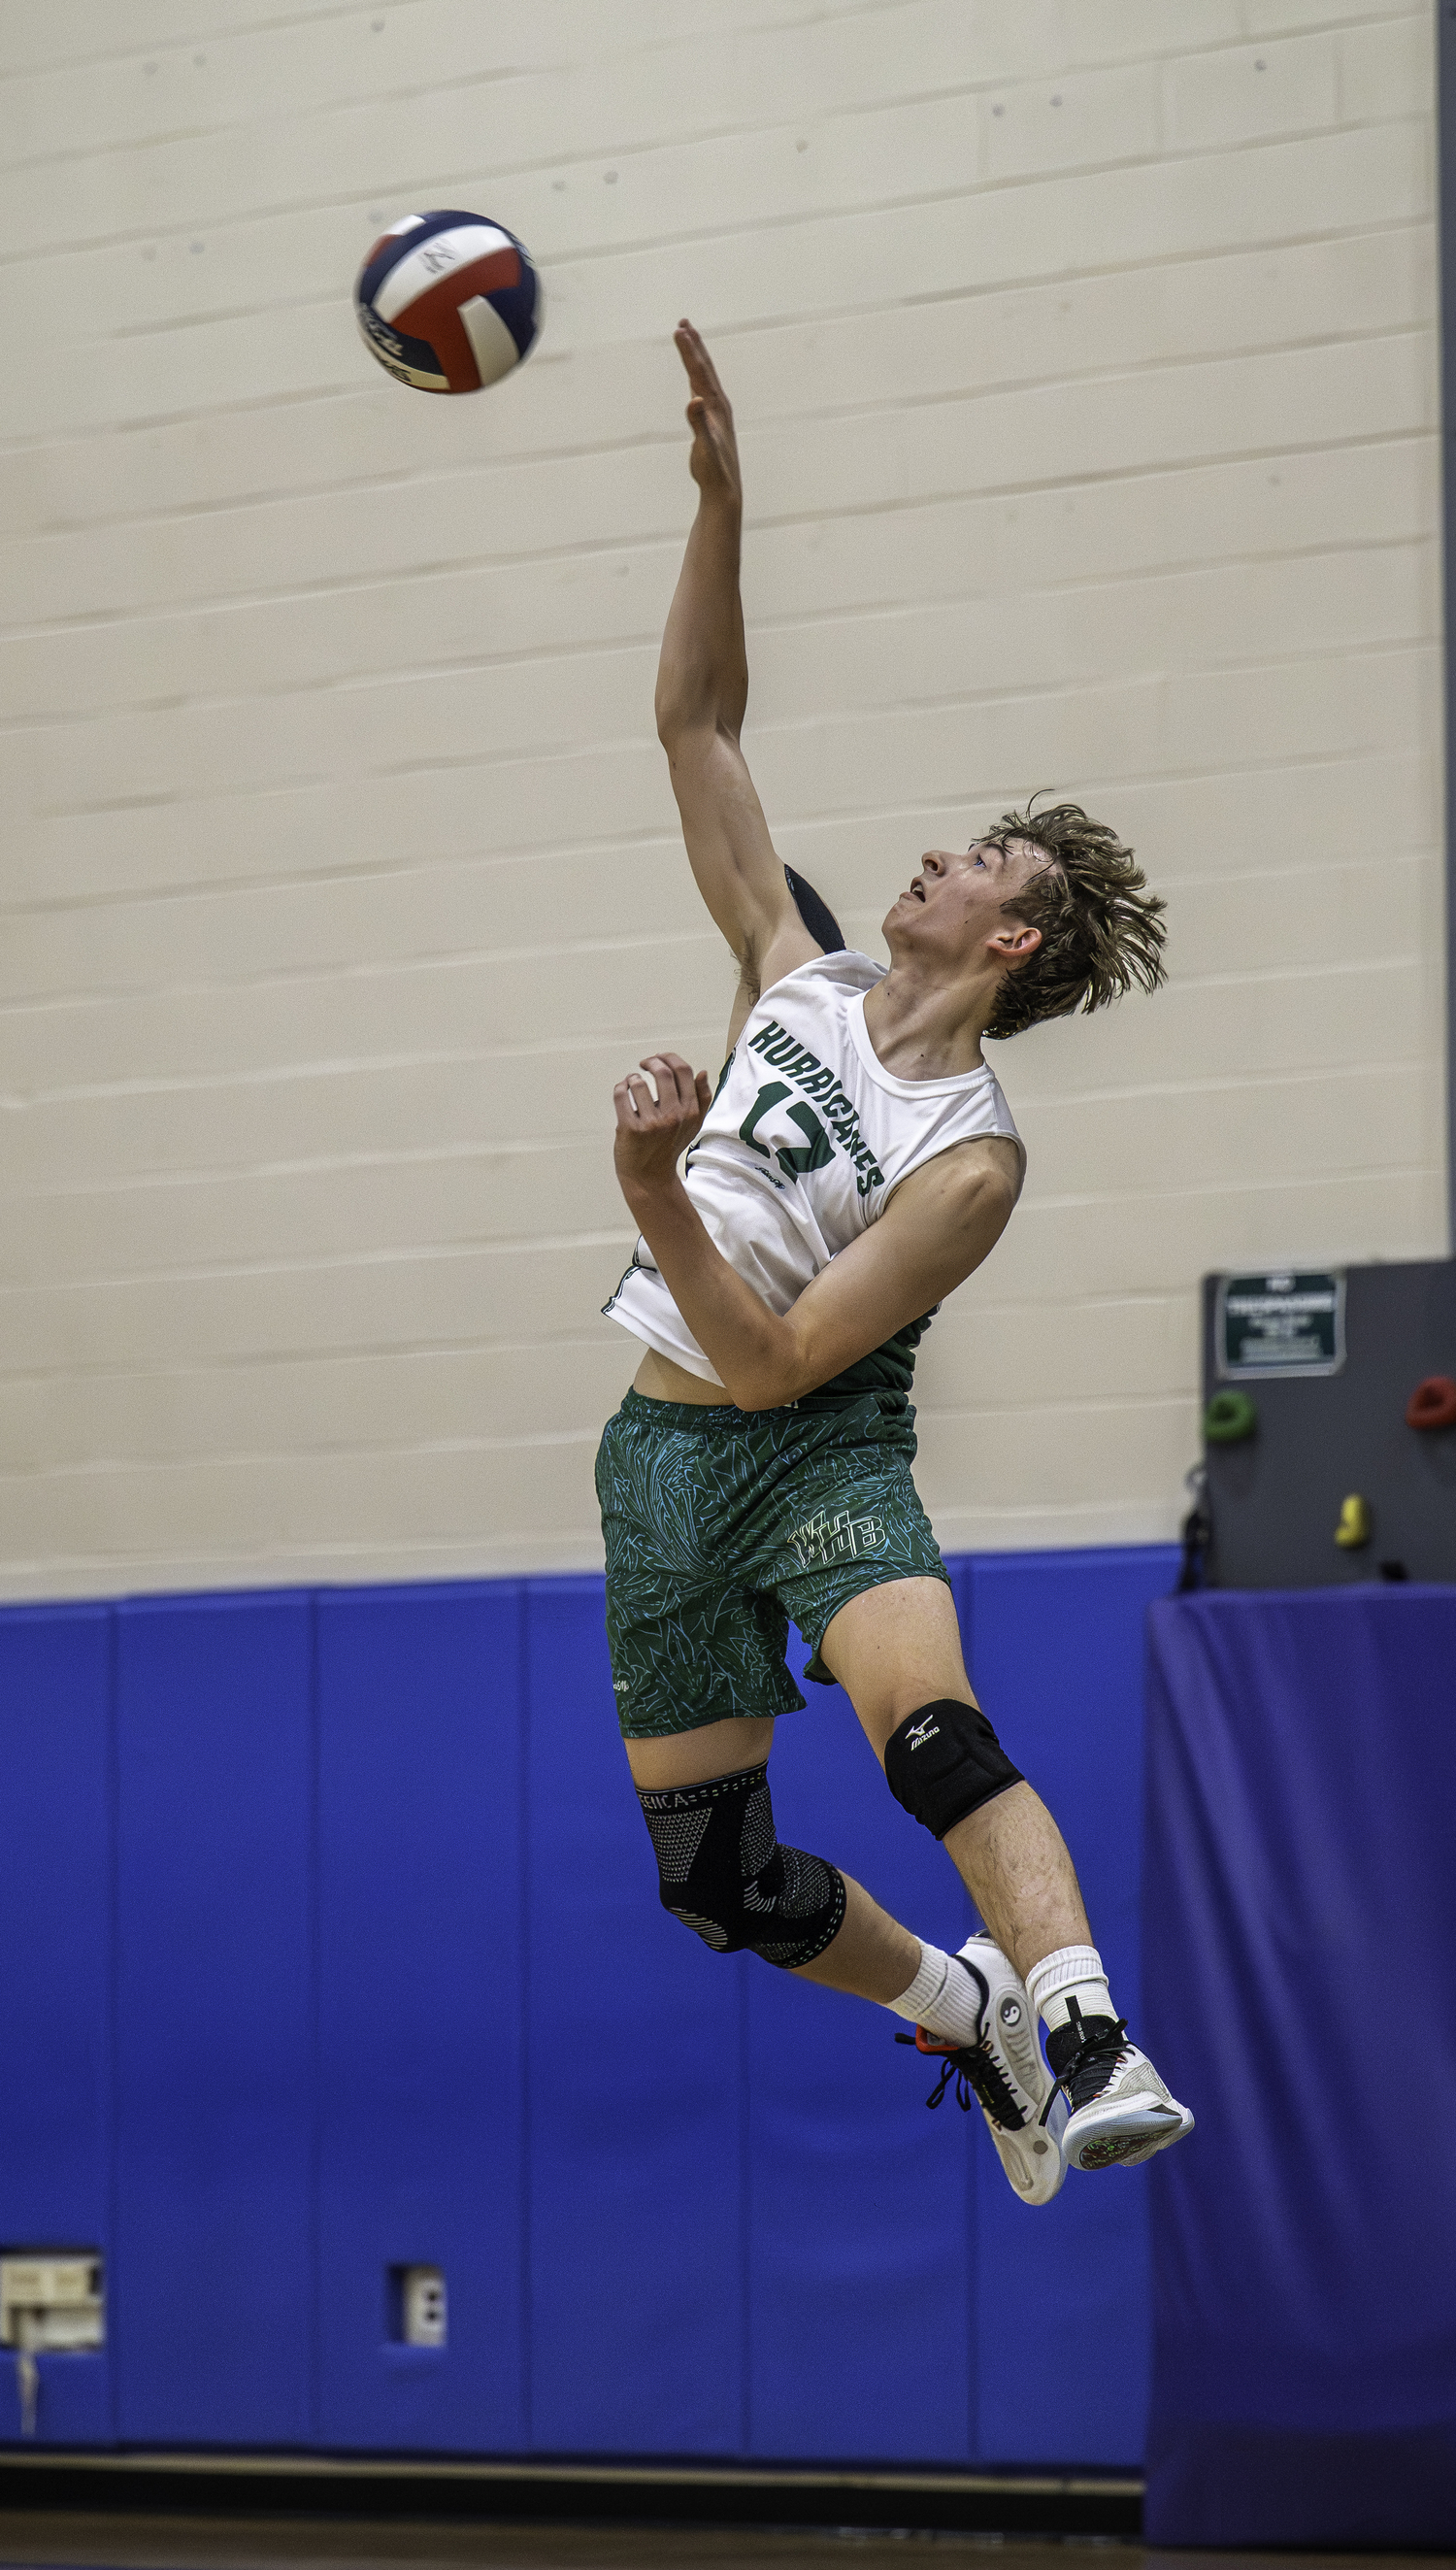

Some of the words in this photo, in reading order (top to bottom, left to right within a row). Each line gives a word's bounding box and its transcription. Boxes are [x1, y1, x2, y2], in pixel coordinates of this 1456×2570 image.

[739, 1080, 837, 1185] 17
[747, 1020, 885, 1198] HURRICANES
[787, 1510, 885, 1569] WHB
